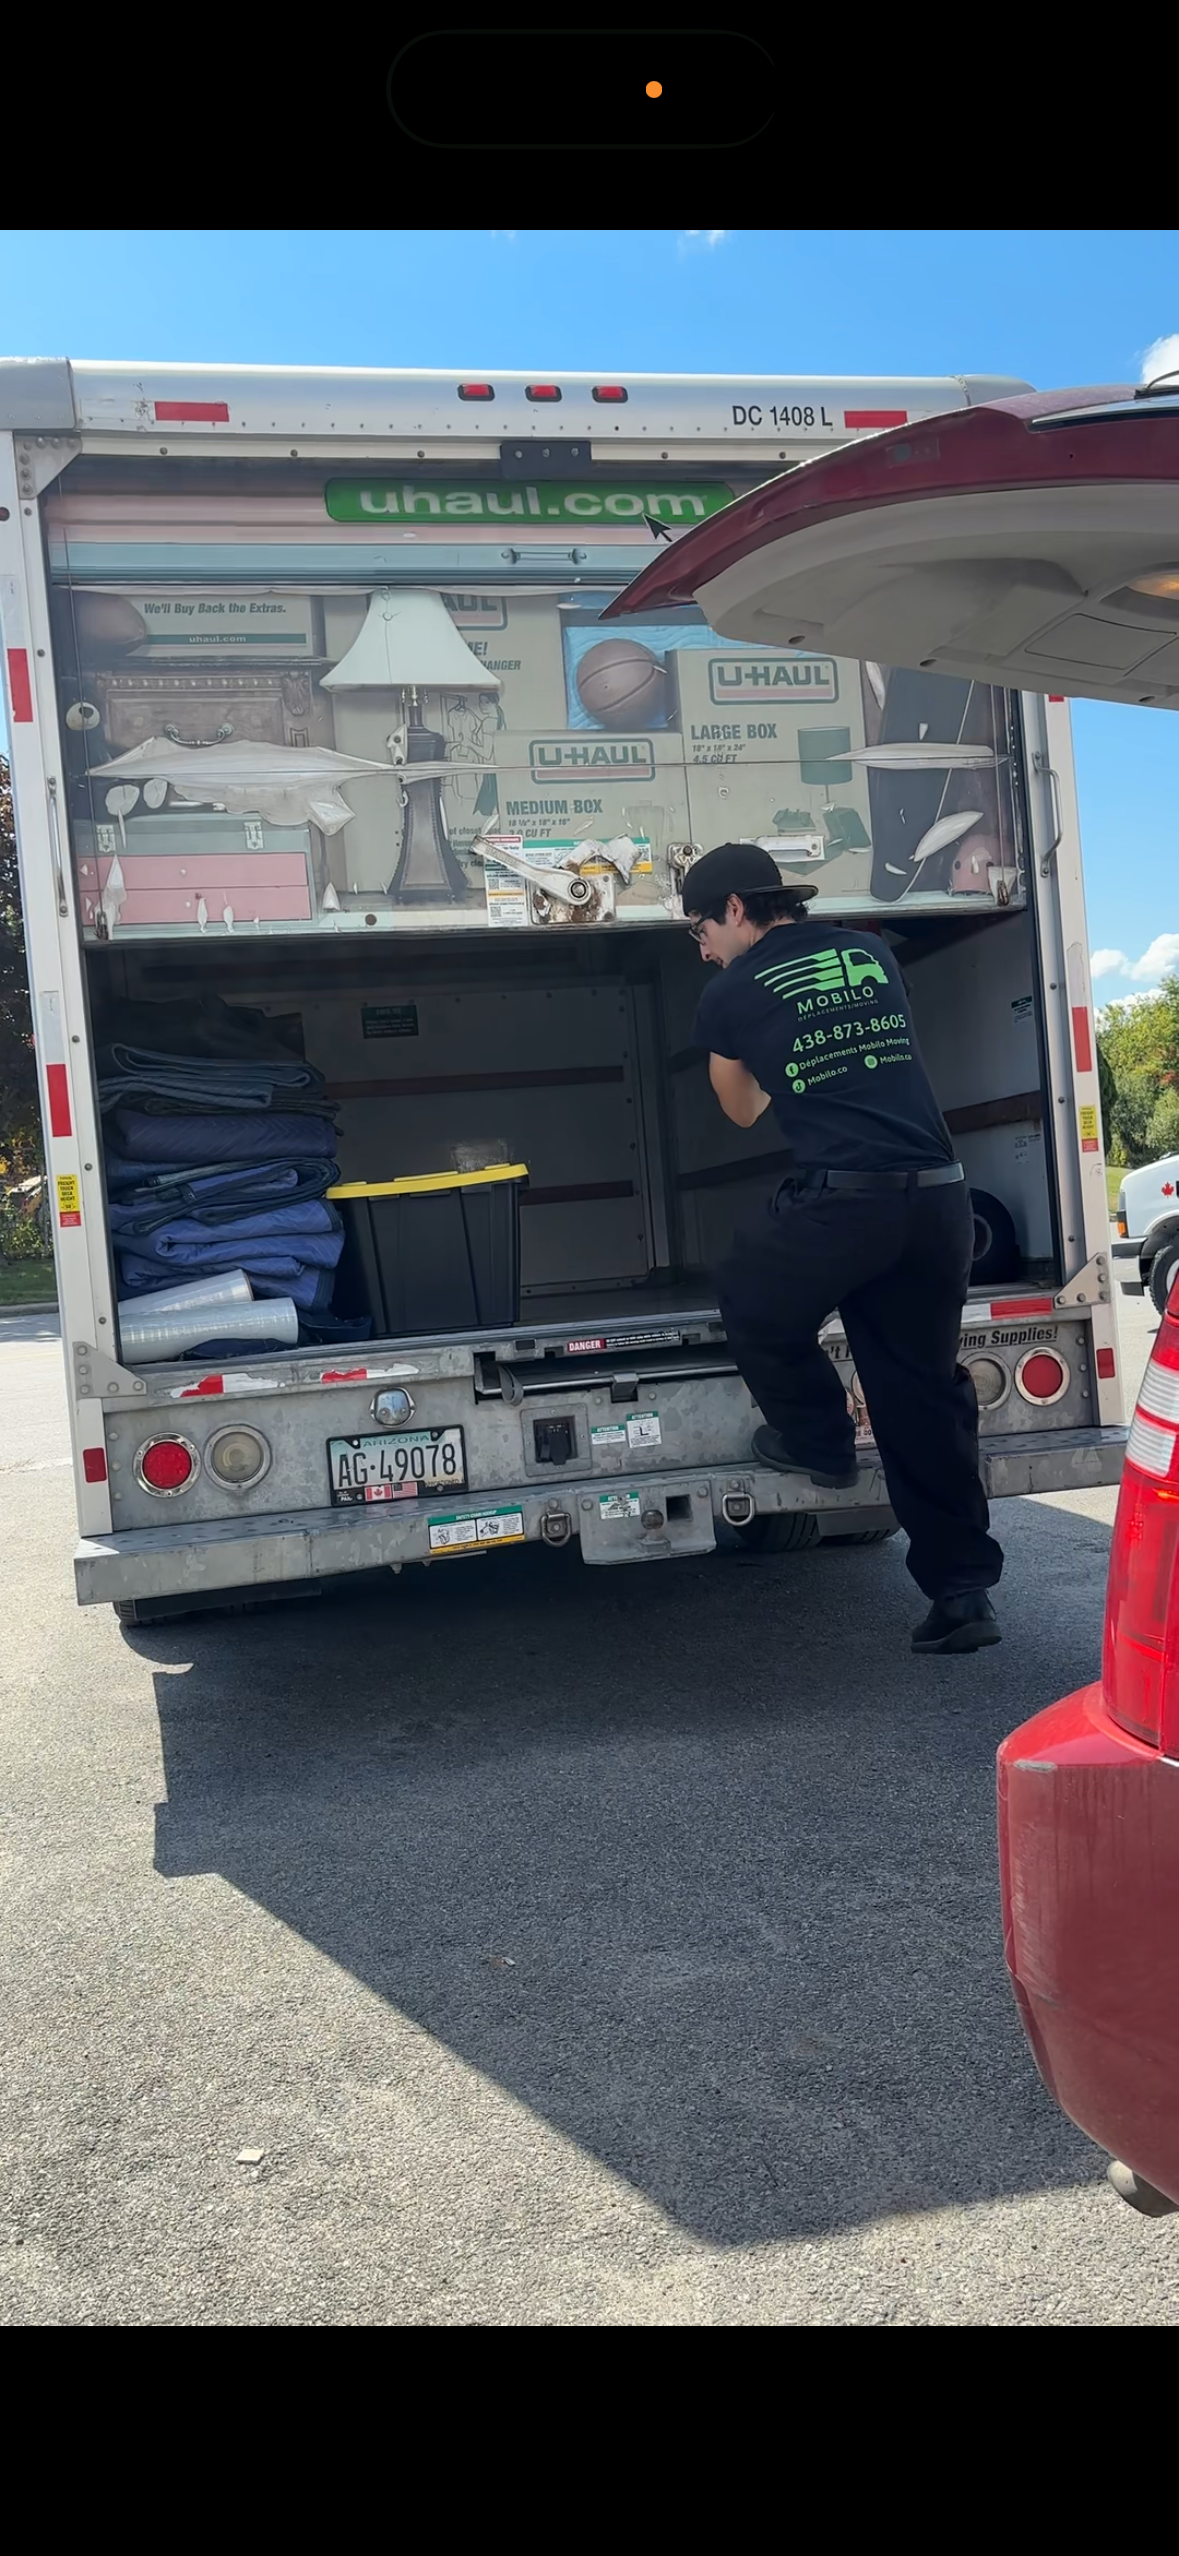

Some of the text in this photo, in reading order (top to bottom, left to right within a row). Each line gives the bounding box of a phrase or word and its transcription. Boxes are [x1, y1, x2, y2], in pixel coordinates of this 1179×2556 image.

[732, 405, 833, 427] DC 1408 L
[359, 485, 705, 517] uhaul.com
[144, 602, 287, 616] We'll Buy Back the Extras.
[188, 634, 247, 643] uhaul.com
[717, 665, 830, 686] U-HAUL
[690, 723, 778, 741] LARGE BOX
[537, 745, 647, 766] U-HAUL
[506, 798, 603, 816] MEDIUM BOX
[796, 985, 874, 1014] MOBILO
[792, 1014, 907, 1053] 438-873-8605
[799, 1046, 858, 1070] Déplacements
[858, 1039, 885, 1052] Mobilo
[807, 1065, 848, 1086] Mobilo.co
[568, 1339, 601, 1352] DANGER
[991, 1325, 1058, 1346] Supplies!
[362, 1434, 431, 1448] ARIZONA
